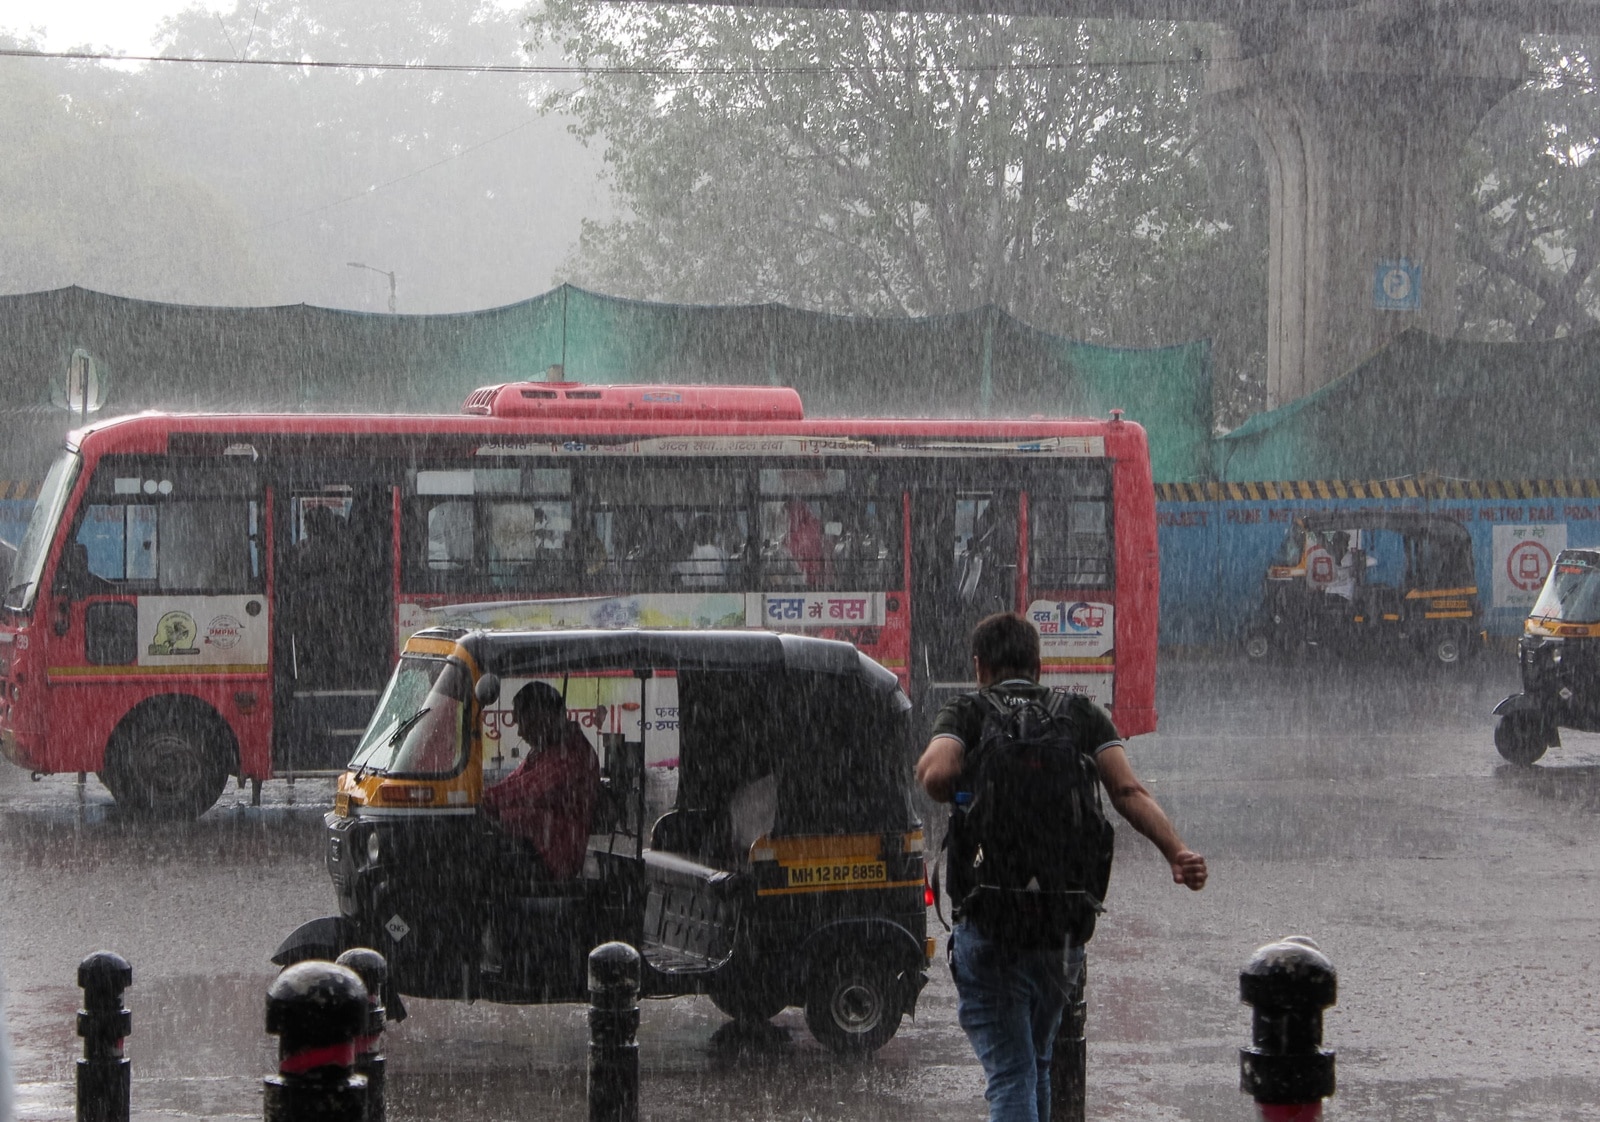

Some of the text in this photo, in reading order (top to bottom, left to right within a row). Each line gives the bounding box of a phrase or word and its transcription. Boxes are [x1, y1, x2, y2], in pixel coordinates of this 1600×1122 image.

[767, 598, 867, 620] दस में बस
[1033, 611, 1051, 622] दस
[1040, 622, 1059, 633] बस
[792, 864, 884, 883] MH 12 RP 8856
